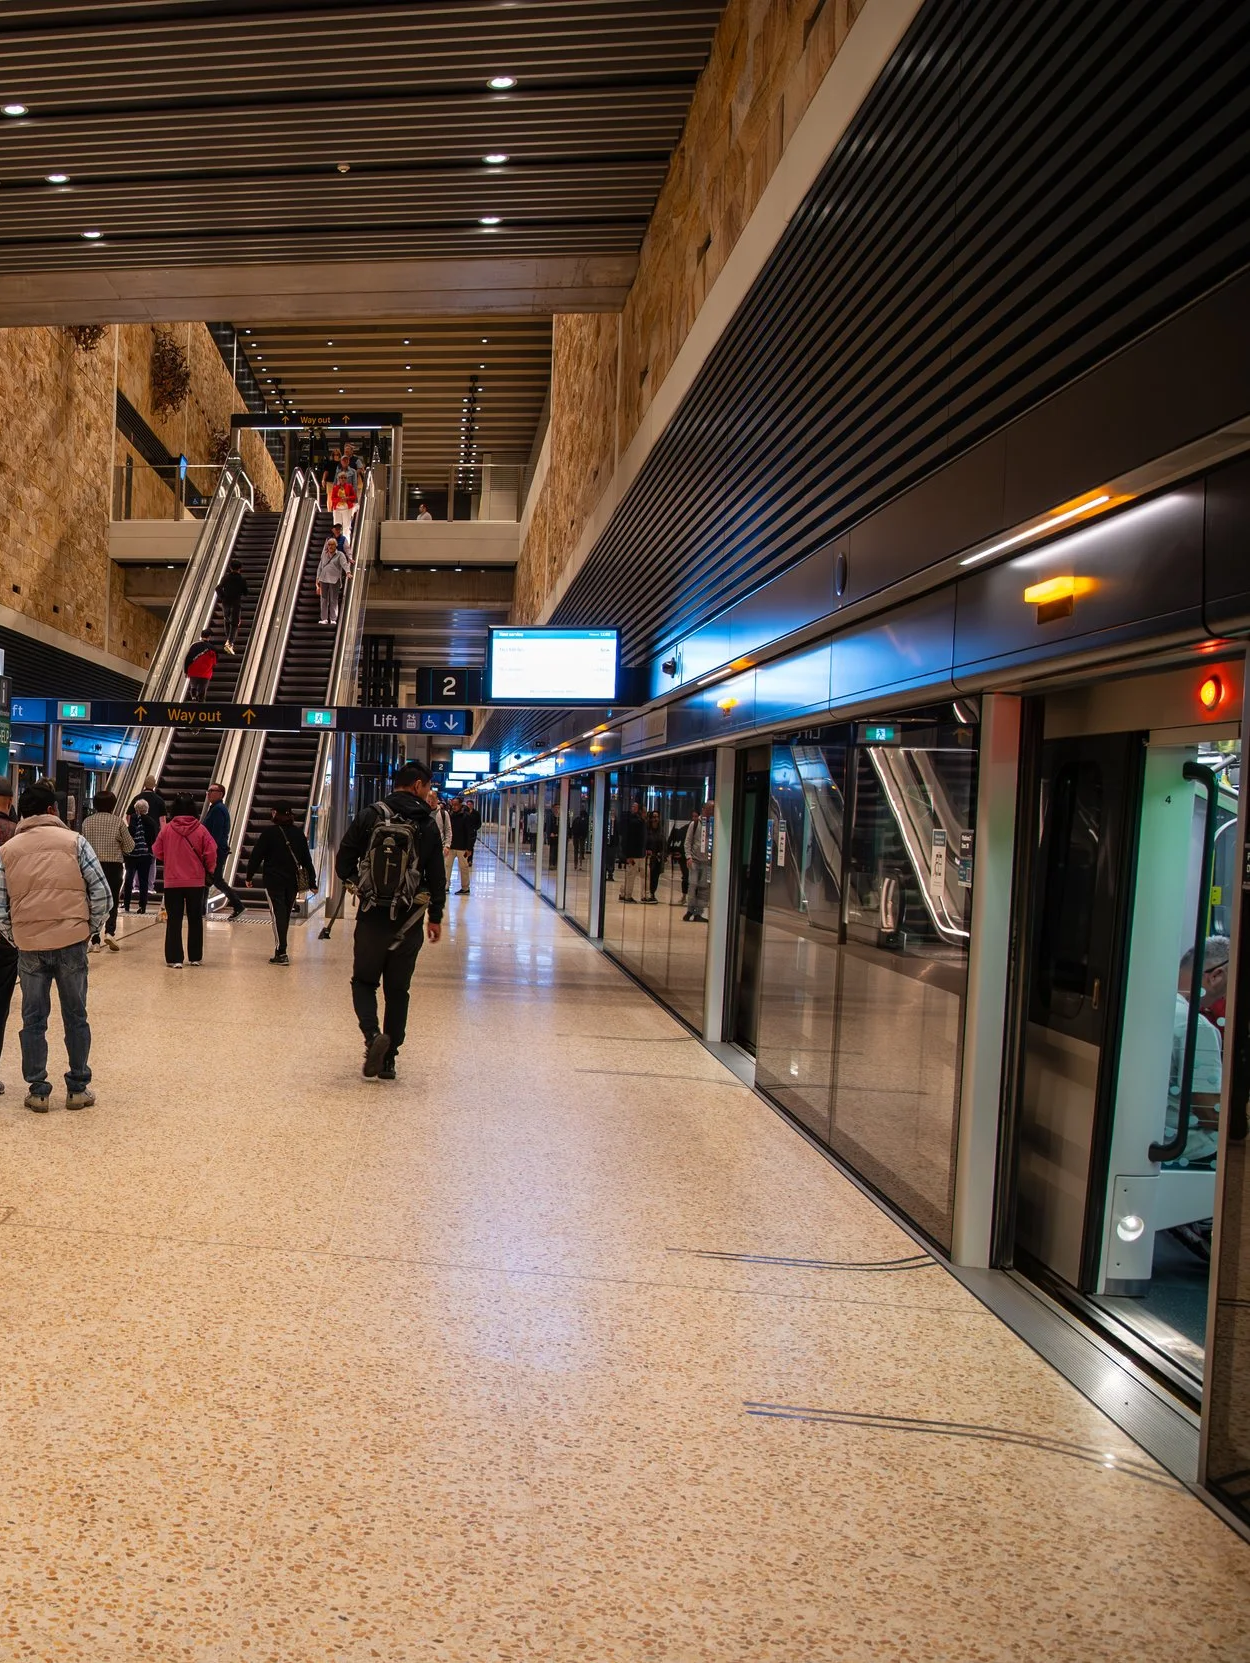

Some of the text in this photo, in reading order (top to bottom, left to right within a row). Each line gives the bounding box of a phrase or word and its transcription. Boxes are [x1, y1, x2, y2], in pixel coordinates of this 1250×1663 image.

[300, 416, 317, 425] Way
[442, 676, 456, 696] 2
[12, 704, 23, 717] ft
[167, 708, 221, 725] Way out
[373, 714, 398, 728] Lift
[438, 763, 444, 771] 2
[1165, 795, 1172, 805] 4
